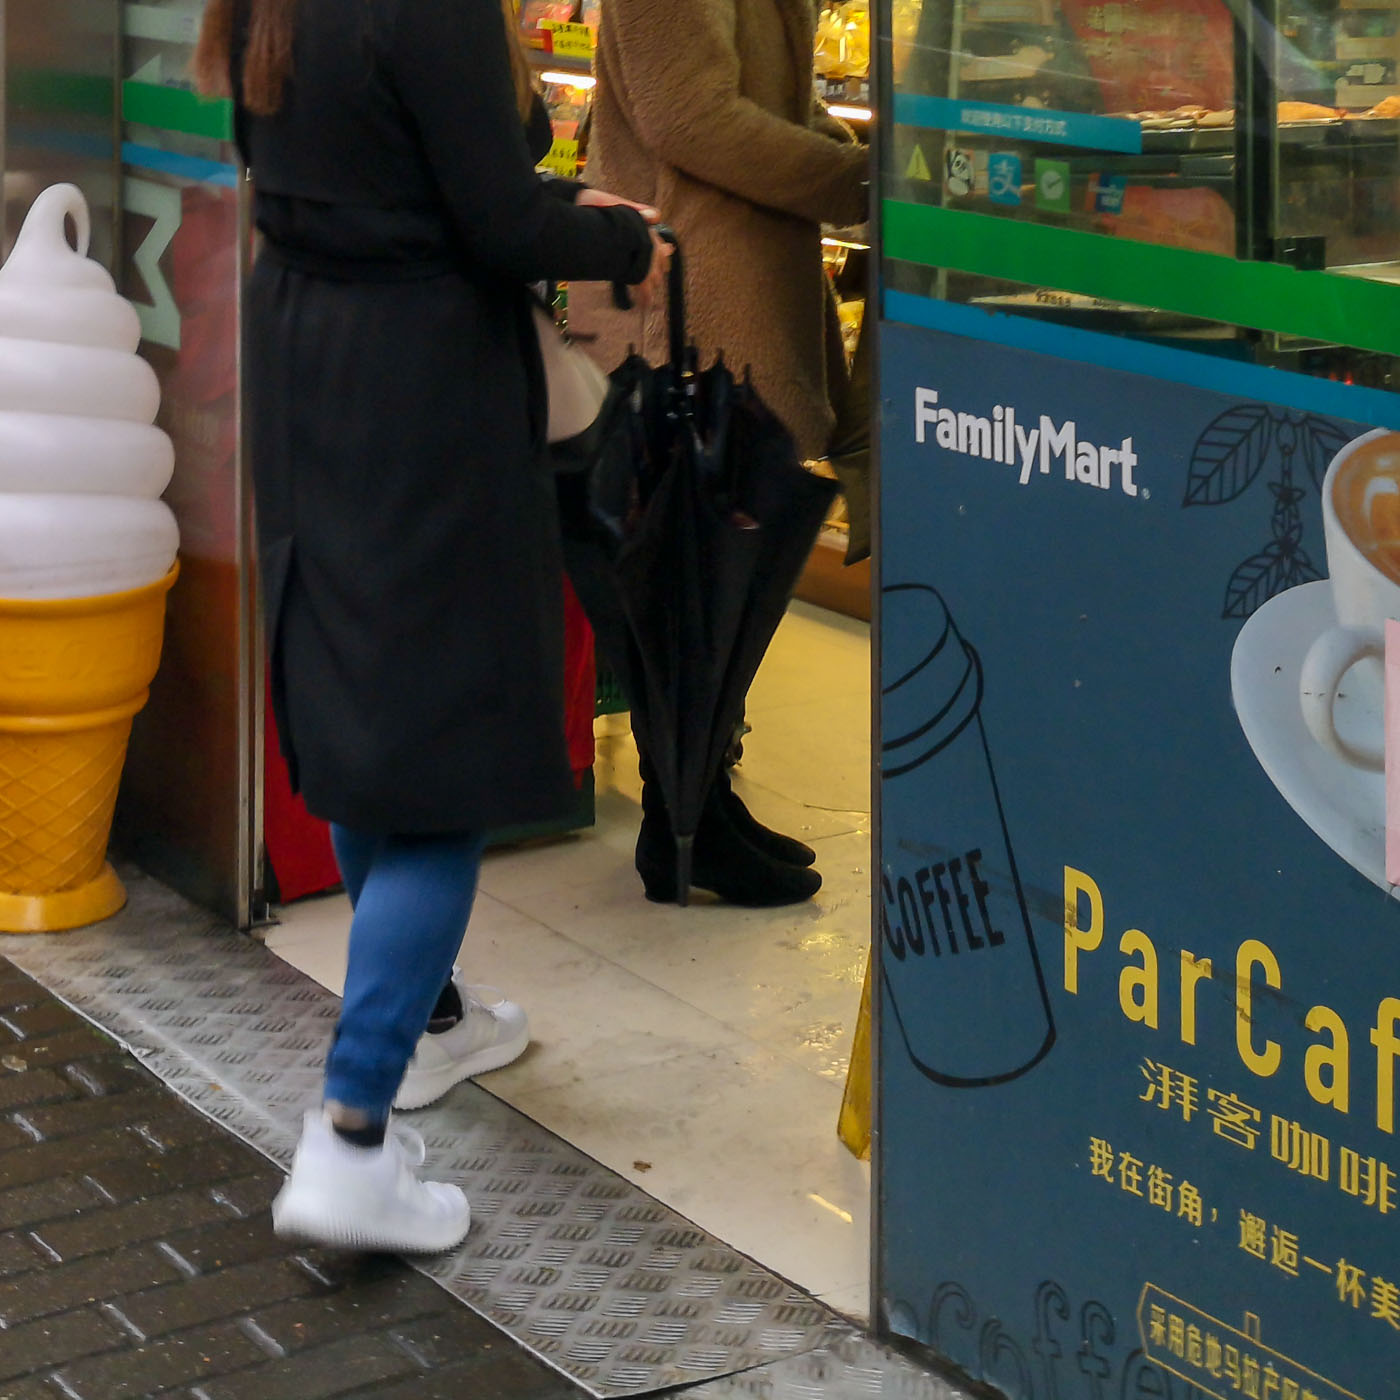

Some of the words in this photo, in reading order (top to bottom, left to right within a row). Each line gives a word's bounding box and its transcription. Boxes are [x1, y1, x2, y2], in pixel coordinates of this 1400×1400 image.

[915, 386, 1138, 497] FamilyMart
[882, 848, 1006, 962] COFFEE
[1138, 1056, 1397, 1214] 湃客咖啡
